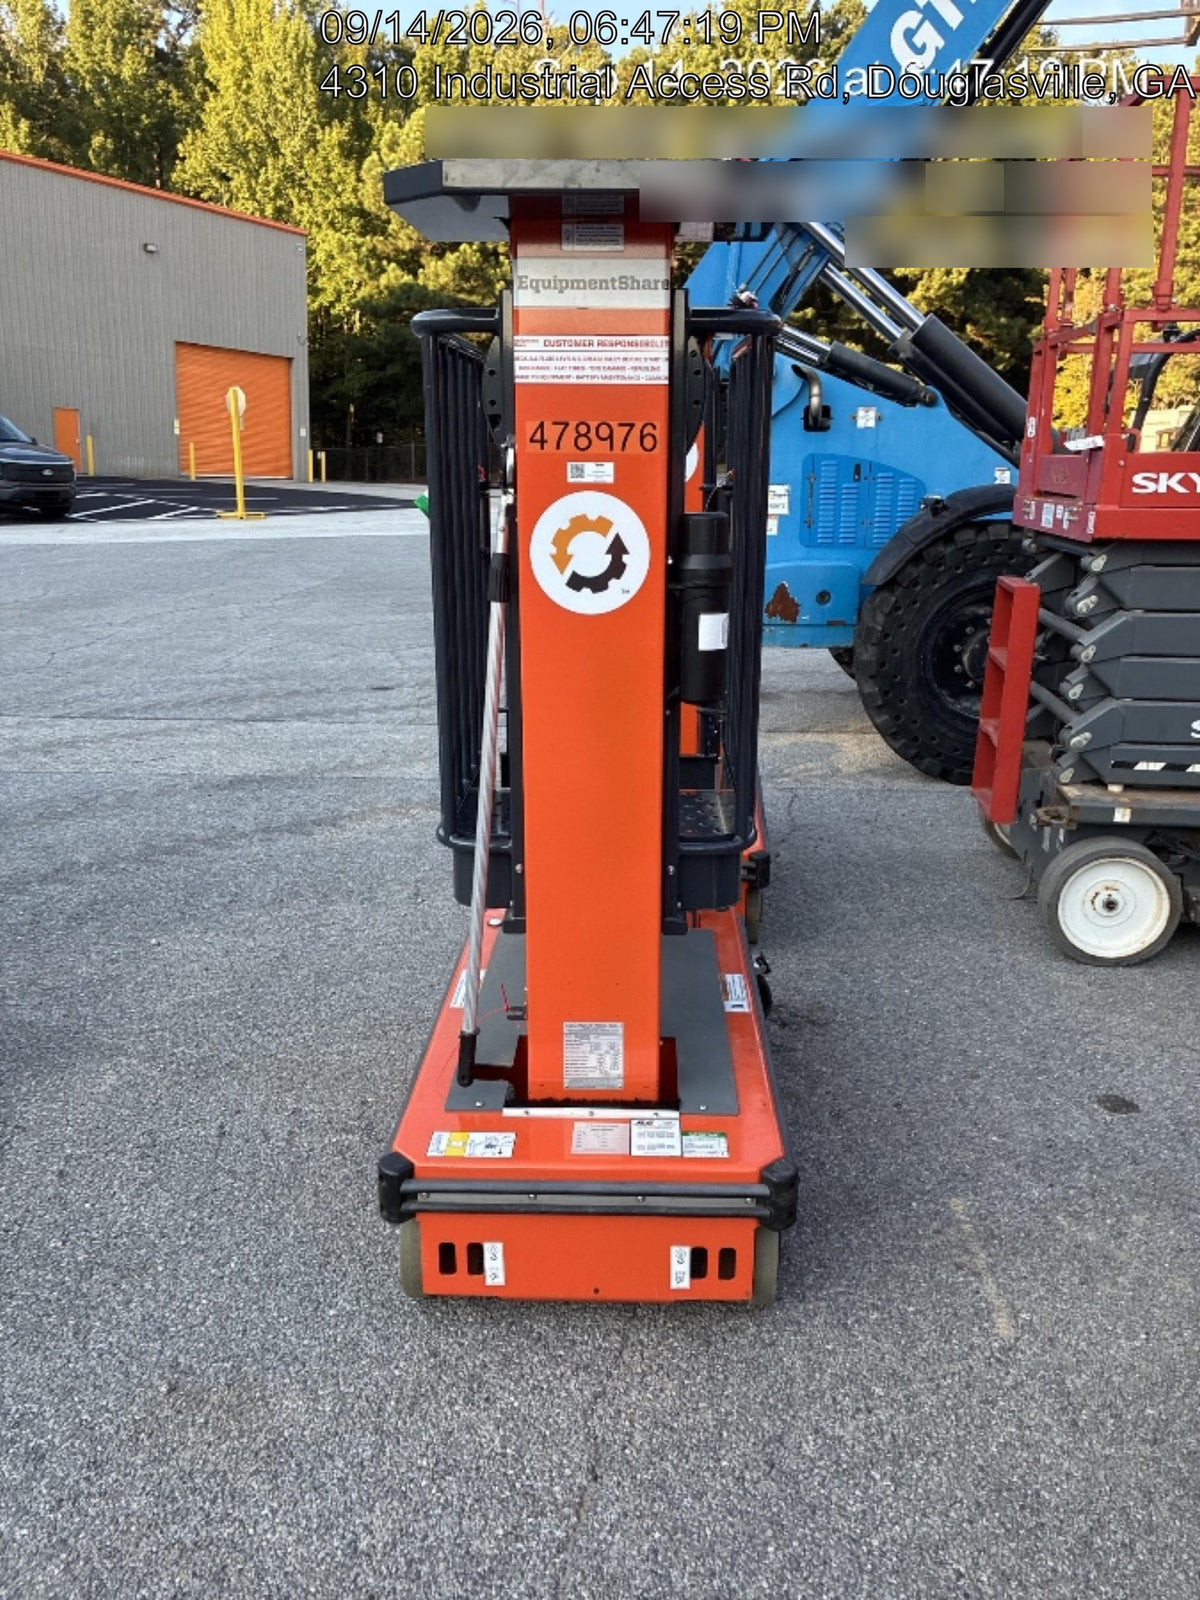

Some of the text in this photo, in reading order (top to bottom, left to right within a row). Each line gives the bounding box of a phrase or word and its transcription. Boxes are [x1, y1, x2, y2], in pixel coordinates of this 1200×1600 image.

[890, 0, 980, 70] GT
[517, 275, 670, 293] EquipmentShare
[543, 339, 595, 348] CUSTOMER
[529, 421, 657, 452] 478976
